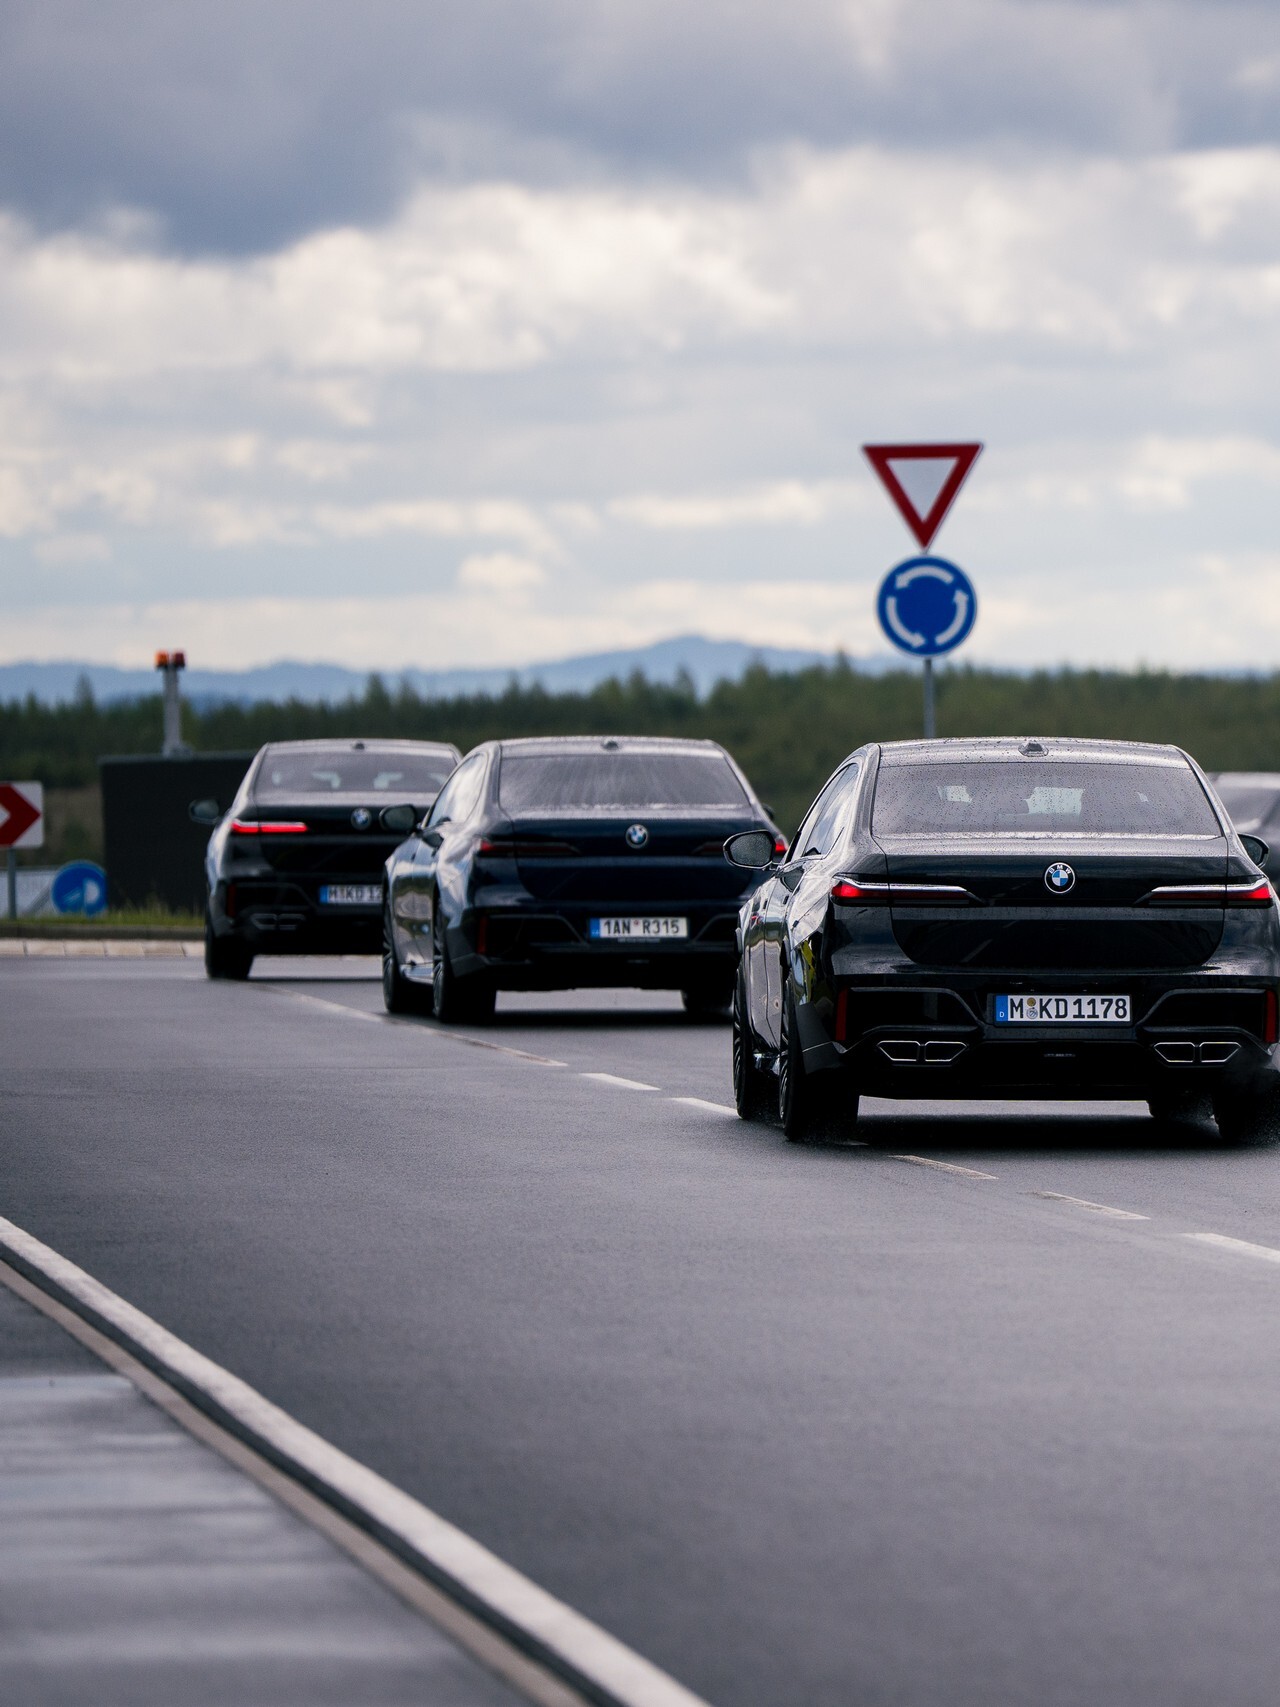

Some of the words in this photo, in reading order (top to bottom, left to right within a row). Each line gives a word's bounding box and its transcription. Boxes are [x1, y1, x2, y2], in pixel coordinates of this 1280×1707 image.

[603, 920, 631, 935] 1AN
[642, 919, 680, 935] R315
[1010, 998, 1024, 1019] M
